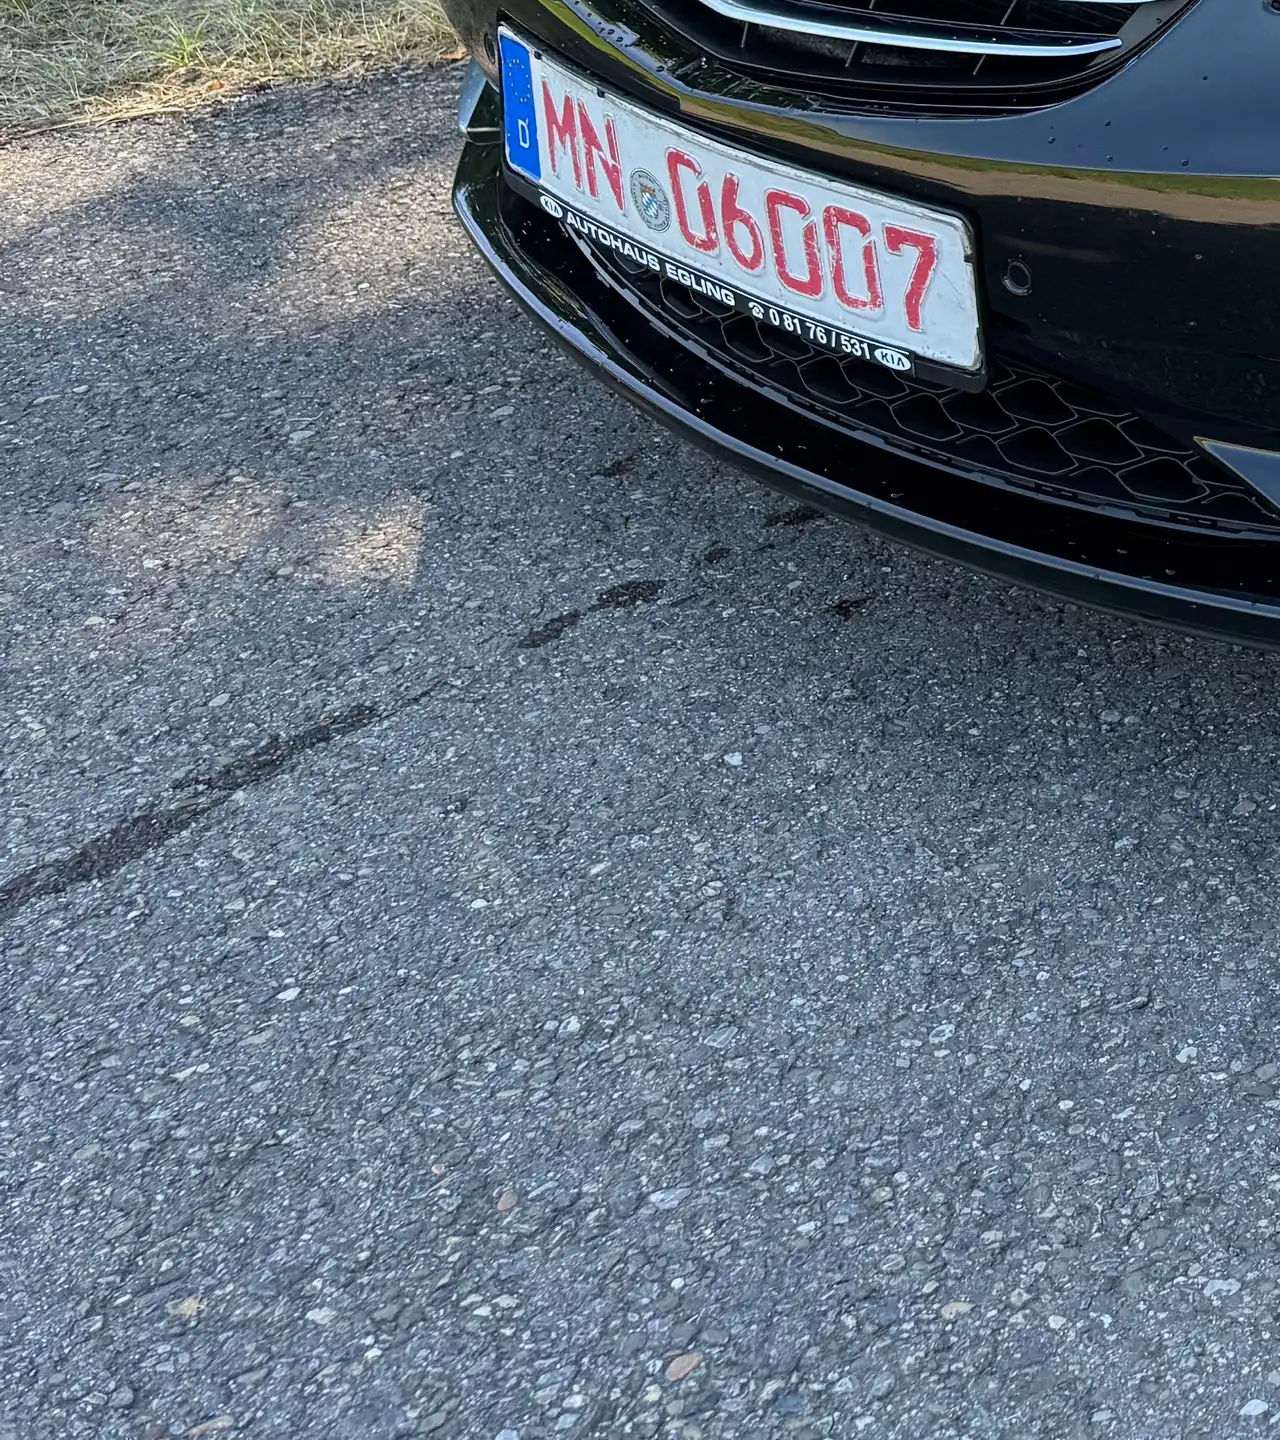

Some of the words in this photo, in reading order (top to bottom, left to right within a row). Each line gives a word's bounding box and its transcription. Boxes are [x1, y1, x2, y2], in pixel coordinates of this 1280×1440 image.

[518, 118, 530, 149] D
[541, 74, 627, 212] MN
[665, 147, 938, 333] 06007
[566, 211, 661, 272] AUTOHAUS
[665, 262, 736, 307] EGLING
[840, 334, 871, 360] 531
[880, 349, 906, 369] KIA
